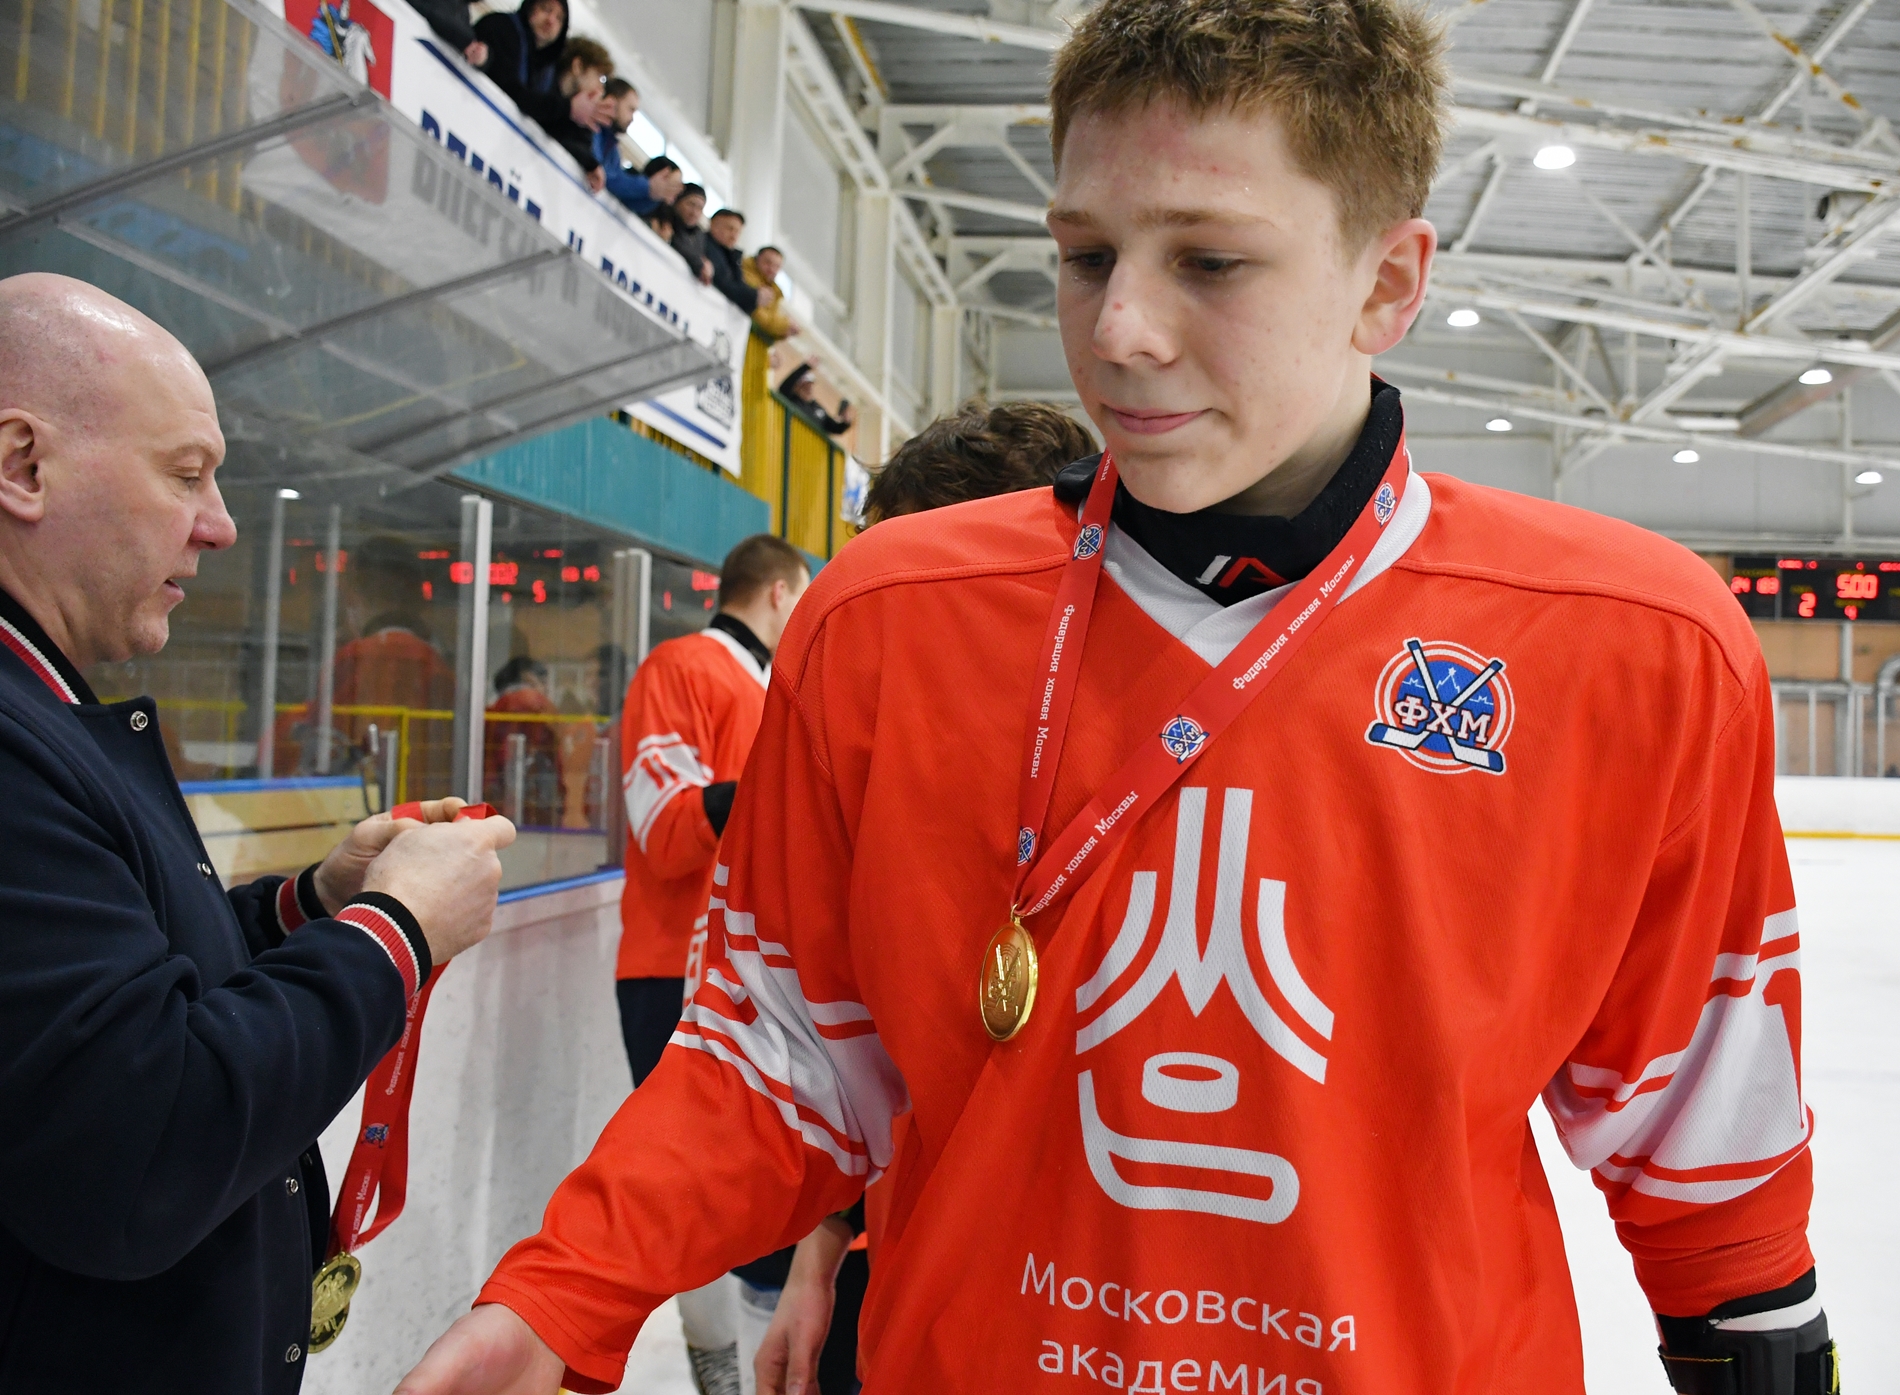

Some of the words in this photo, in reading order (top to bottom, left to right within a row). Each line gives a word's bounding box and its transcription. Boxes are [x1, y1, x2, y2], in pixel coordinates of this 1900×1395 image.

[1233, 633, 1288, 689] Федерация
[1287, 598, 1321, 634] хоккея
[1319, 555, 1355, 598] Москвы
[1798, 592, 1817, 617] 2
[1049, 604, 1075, 672] Федерация
[1040, 678, 1055, 720] хоккея
[1393, 694, 1492, 745] ФХМ
[1031, 726, 1049, 778] Москвы
[1026, 873, 1067, 915] дерация
[1065, 836, 1098, 874] хоккея
[1094, 790, 1139, 836] Москвы
[1020, 1252, 1356, 1351] Московская
